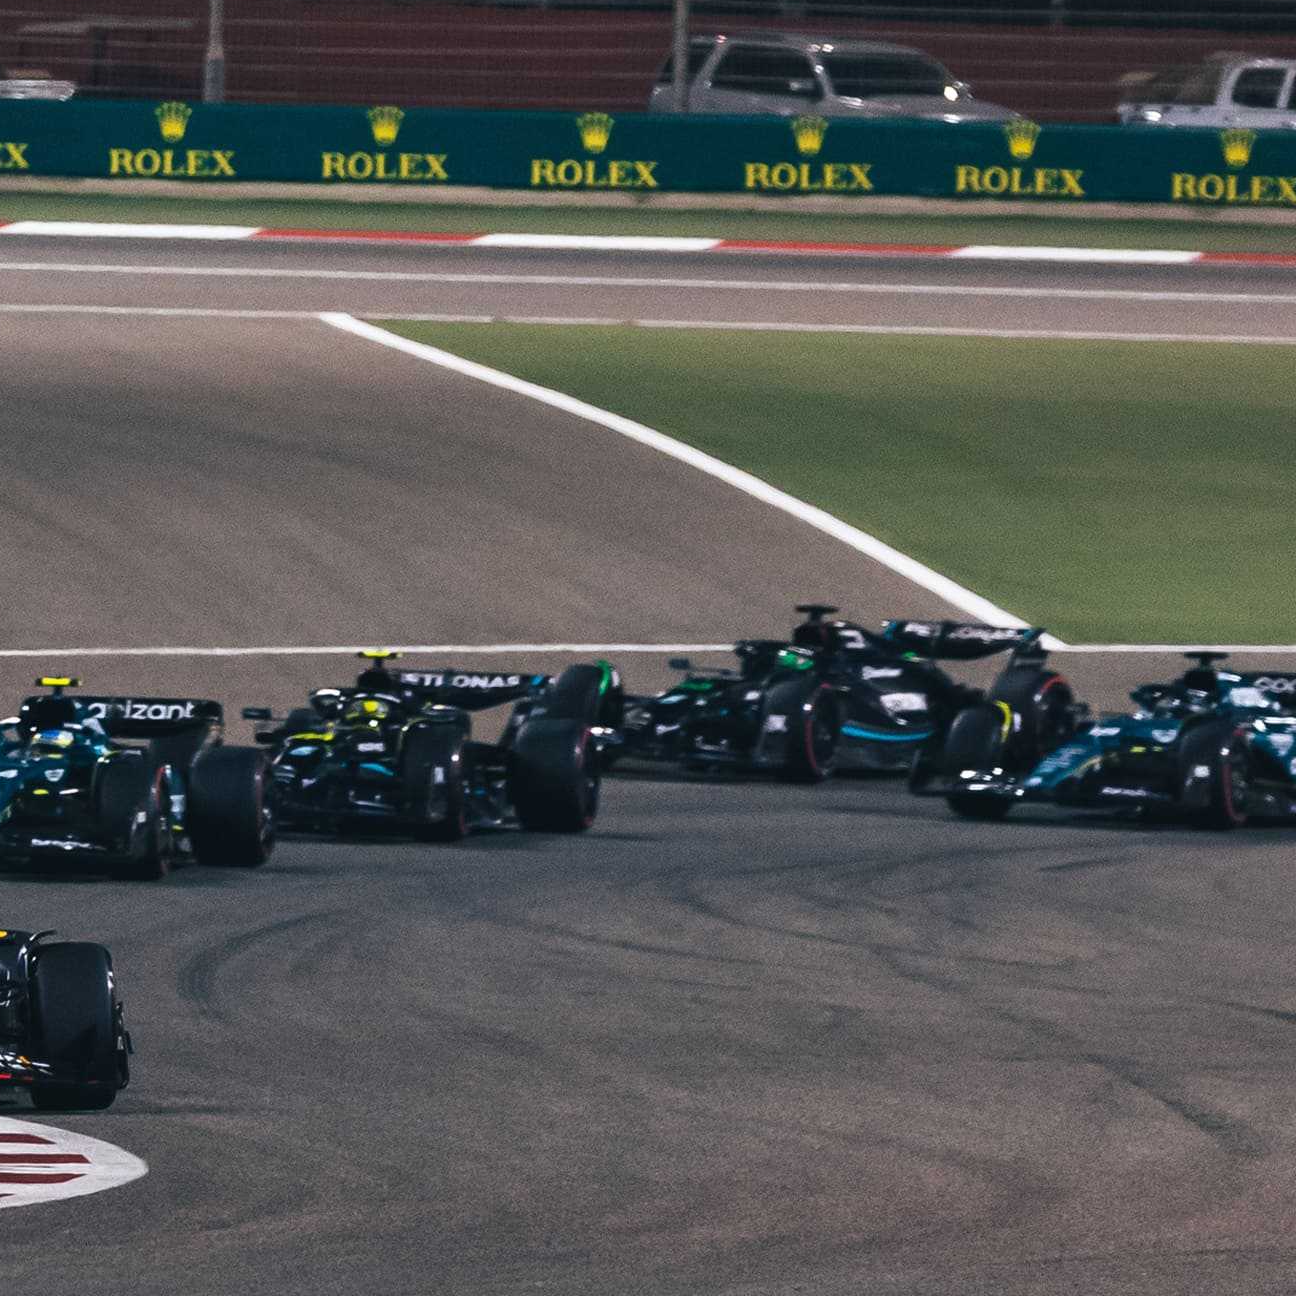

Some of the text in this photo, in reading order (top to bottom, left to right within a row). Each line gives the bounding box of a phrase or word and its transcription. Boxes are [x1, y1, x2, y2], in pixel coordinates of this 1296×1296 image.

[110, 148, 234, 177] ROLEX
[322, 152, 448, 180] ROLEX
[531, 159, 656, 188] ROLEX
[745, 163, 871, 190] ROLEX
[956, 165, 1084, 197] ROLEX
